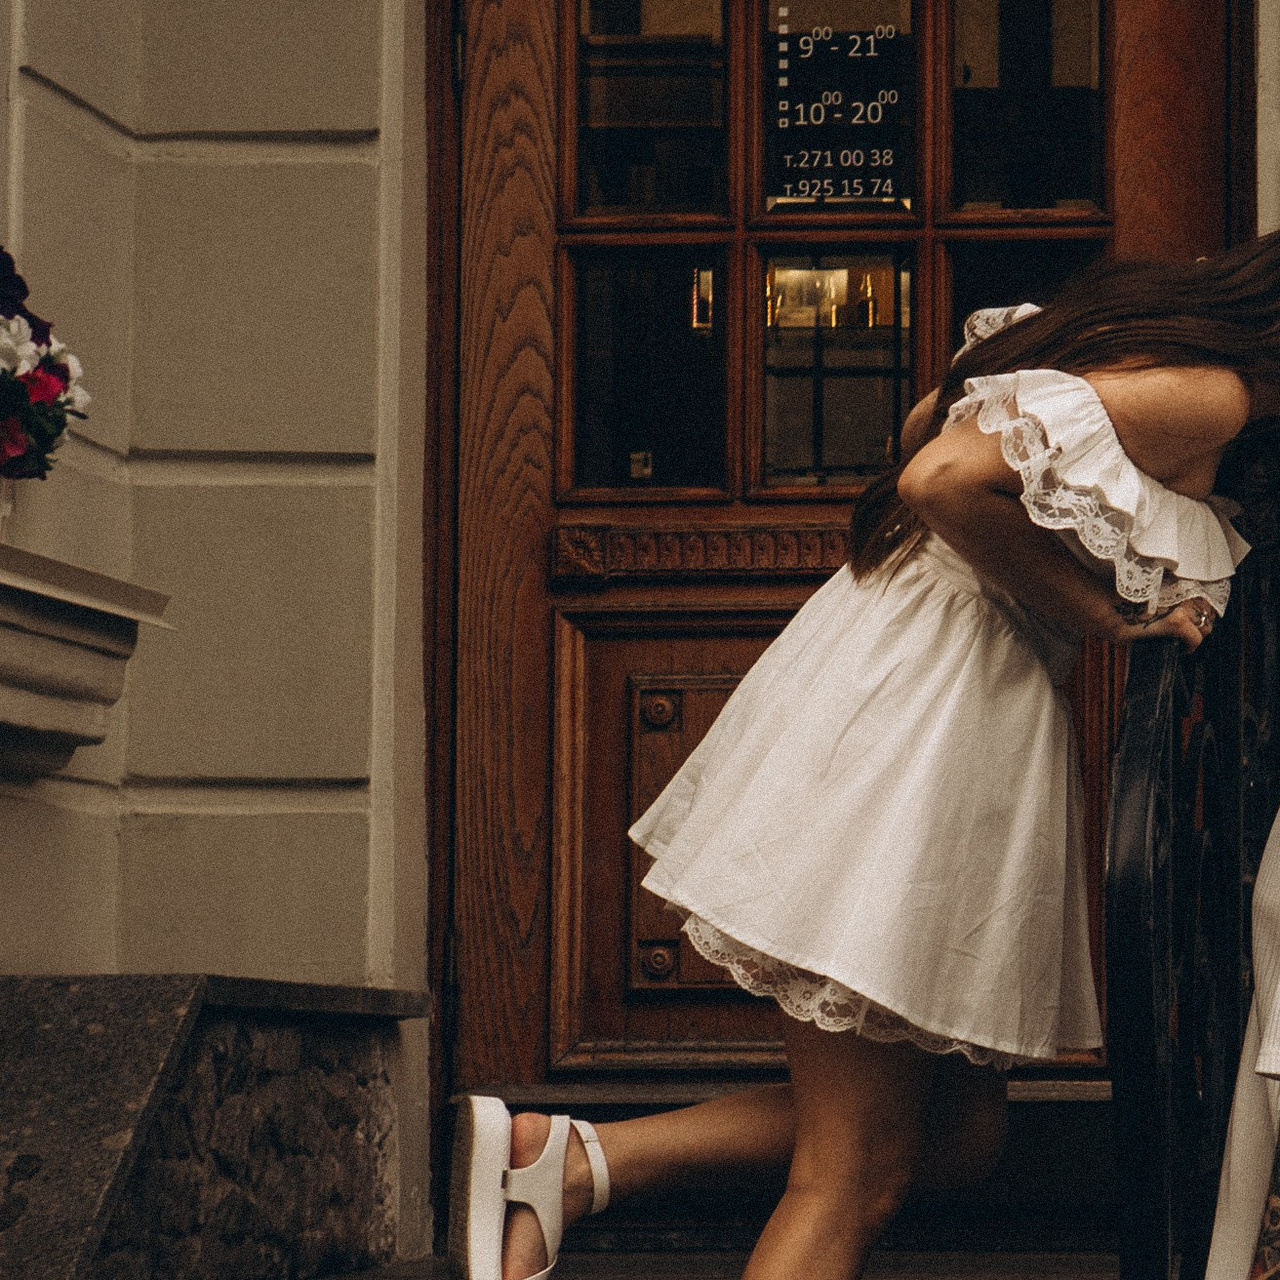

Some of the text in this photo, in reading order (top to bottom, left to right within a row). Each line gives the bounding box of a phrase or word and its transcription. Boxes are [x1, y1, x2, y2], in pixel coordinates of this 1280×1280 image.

[784, 150, 894, 167] т.271 00 38
[842, 180, 863, 196] 15
[871, 179, 893, 195] 74
